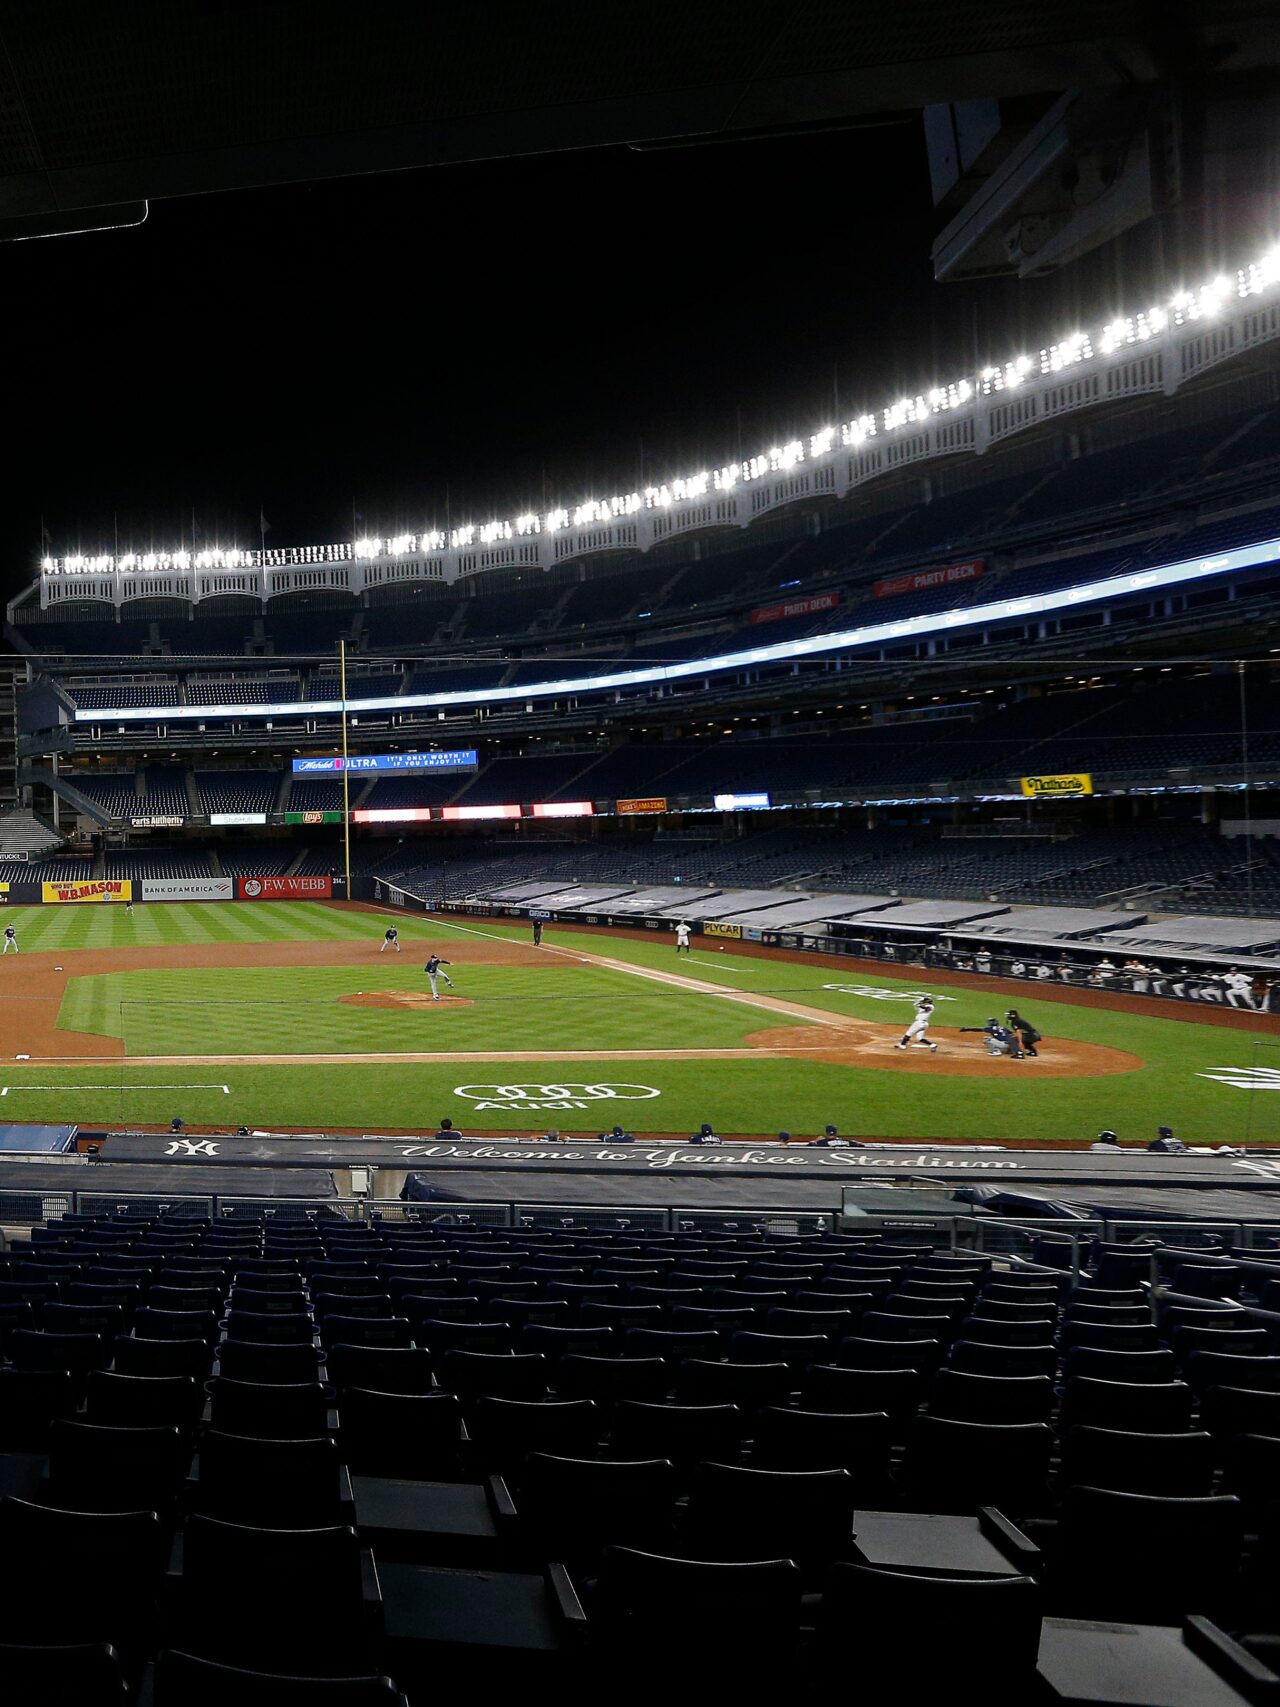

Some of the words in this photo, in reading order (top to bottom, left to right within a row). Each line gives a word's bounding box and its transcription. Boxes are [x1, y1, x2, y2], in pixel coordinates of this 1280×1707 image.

[914, 572, 947, 588] PARTY
[947, 566, 976, 581] DECK
[784, 602, 809, 616] PARTY
[810, 598, 833, 612] DECK
[132, 817, 150, 825] Parts
[151, 816, 184, 825] Authority
[58, 882, 122, 900] W.B.MASON
[178, 885, 214, 893] AMERICA
[264, 880, 285, 890] F.W.
[289, 879, 326, 890] WEBB
[704, 923, 739, 934] PLYCAR
[475, 1100, 589, 1111] Audi
[164, 1139, 221, 1156] NY
[394, 1144, 584, 1160] Welcome
[590, 1149, 636, 1161] to
[632, 1148, 808, 1168] Yankee
[818, 1152, 1026, 1169] Stadium
